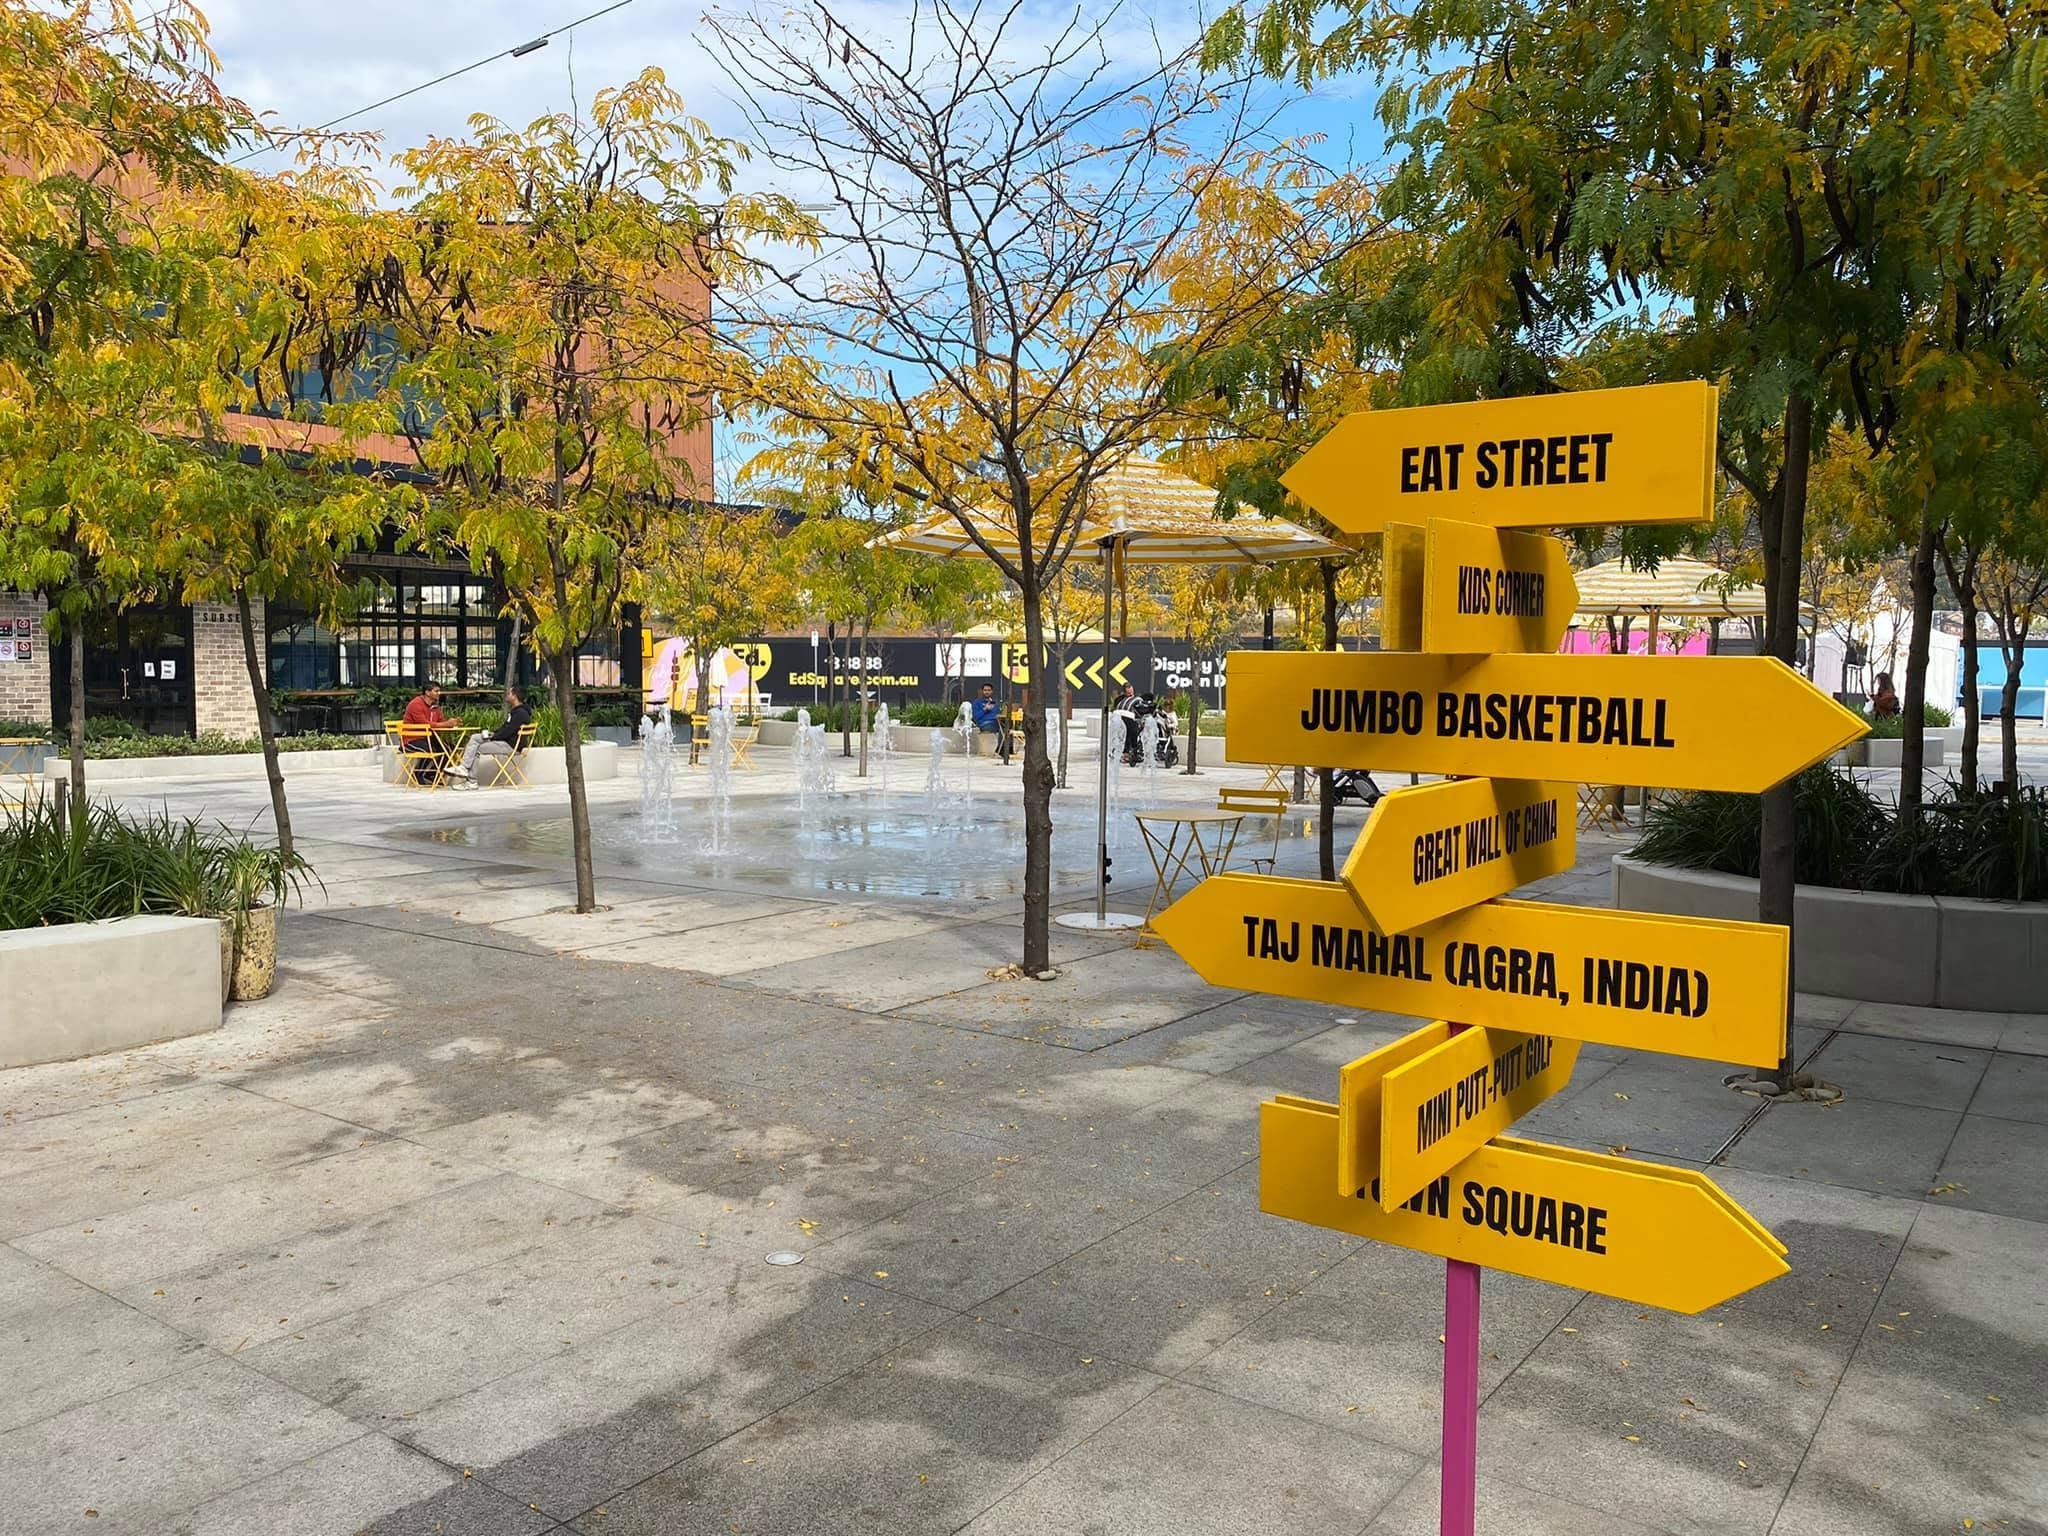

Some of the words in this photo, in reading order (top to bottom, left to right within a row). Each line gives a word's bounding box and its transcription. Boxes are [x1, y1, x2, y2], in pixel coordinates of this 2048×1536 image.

[1400, 443, 1465, 494] EAT
[1475, 432, 1614, 489] STREET
[203, 613, 240, 623] SUBSE
[1458, 565, 1491, 615] KIDS
[1495, 569, 1545, 617] CORNER
[789, 672, 919, 688] EdSqaecom.au
[1151, 657, 1212, 674] Disply
[1166, 673, 1210, 689] Opn
[1301, 689, 1424, 735] JUMBO
[1436, 692, 1676, 748] BASKETBALL
[1413, 825, 1462, 885] GREAT
[1465, 814, 1502, 868] WALL
[1505, 808, 1521, 855] OF
[1523, 798, 1558, 848] CHINA
[1243, 915, 1300, 963] TAJ
[1312, 924, 1433, 982] MAHAL
[1444, 941, 1570, 1006] (AGRA,
[1583, 957, 1709, 1018] INDIA)
[1417, 1087, 1452, 1154] MINI
[1456, 1044, 1523, 1128] PUTT-PUTT
[1525, 1034, 1553, 1080] GOLF
[1462, 1180, 1608, 1254] SQUARE
